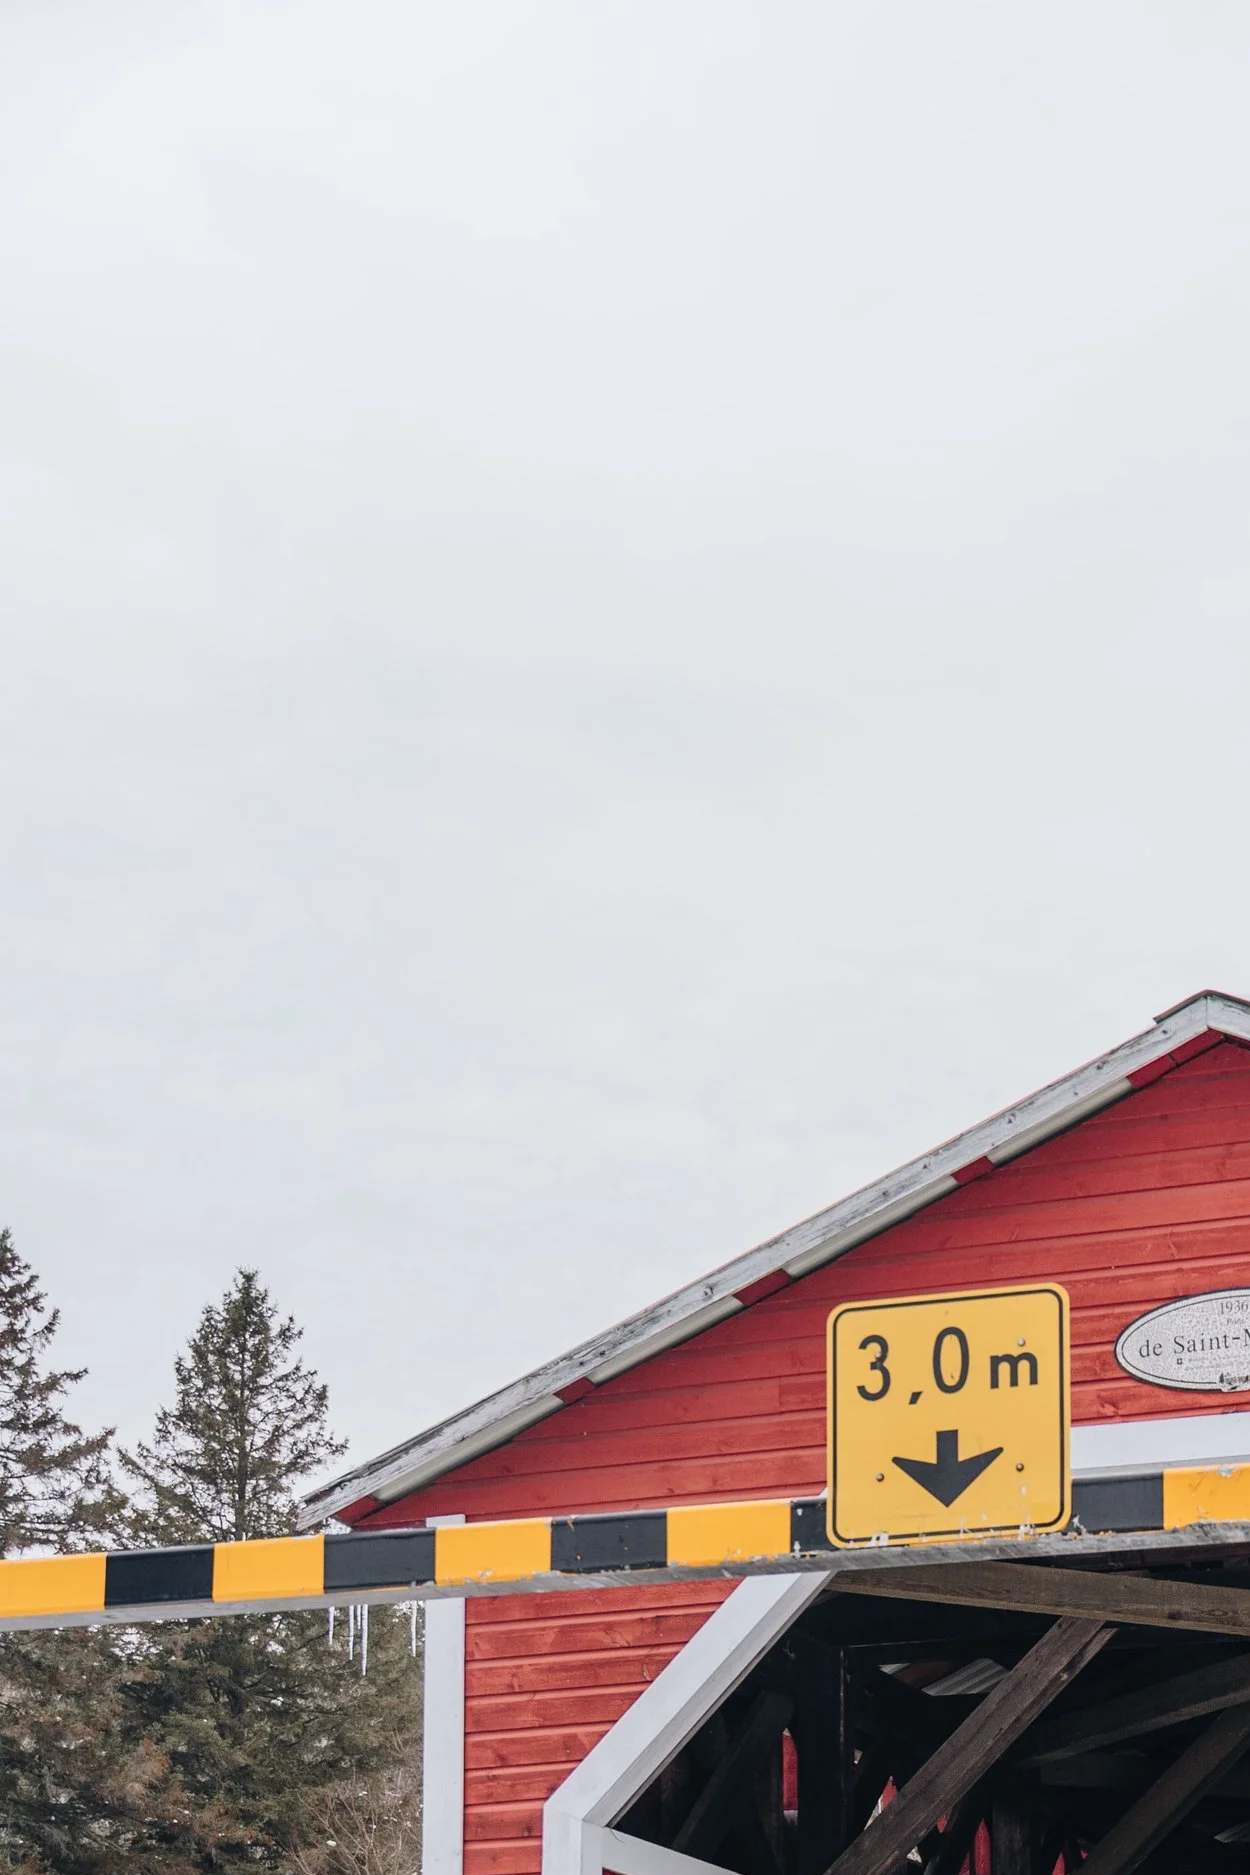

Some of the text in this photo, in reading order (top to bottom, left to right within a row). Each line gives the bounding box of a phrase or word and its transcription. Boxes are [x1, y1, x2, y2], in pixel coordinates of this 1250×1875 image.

[1219, 1299, 1249, 1314] 1936
[1139, 1339, 1162, 1358] de
[856, 1326, 1038, 1405] 3,0 m
